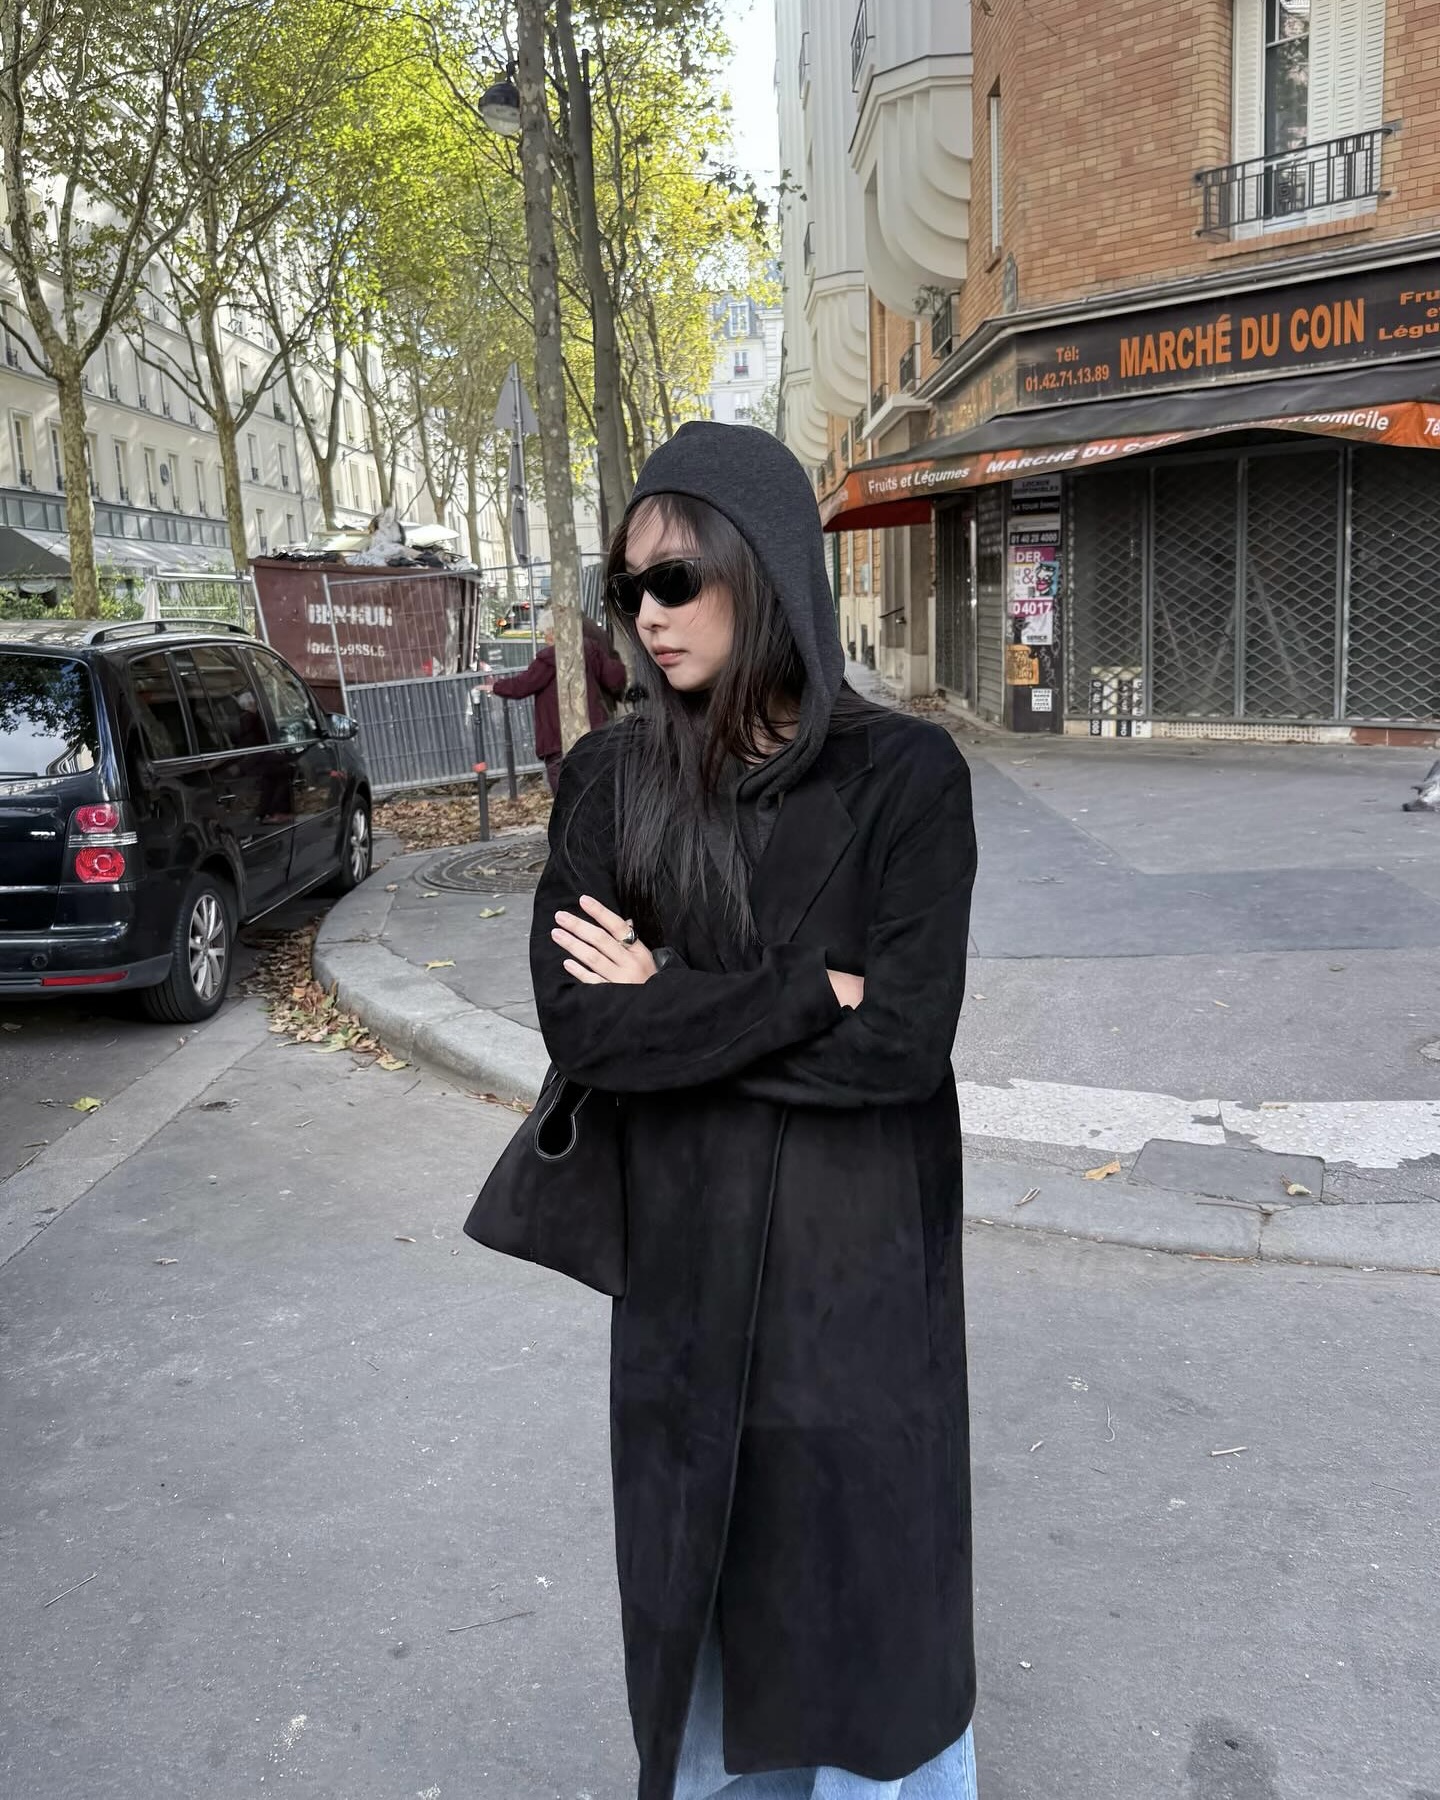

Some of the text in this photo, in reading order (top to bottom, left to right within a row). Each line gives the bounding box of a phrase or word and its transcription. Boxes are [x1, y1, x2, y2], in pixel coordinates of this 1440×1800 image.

[1426, 307, 1440, 318] e
[1120, 298, 1365, 378] MARCHÉ DU COIN
[1056, 346, 1079, 362] Tél:
[1025, 365, 1110, 391] 01.42.71.13.89
[1081, 444, 1118, 459] DU
[868, 467, 970, 494] Fruits et Légumes
